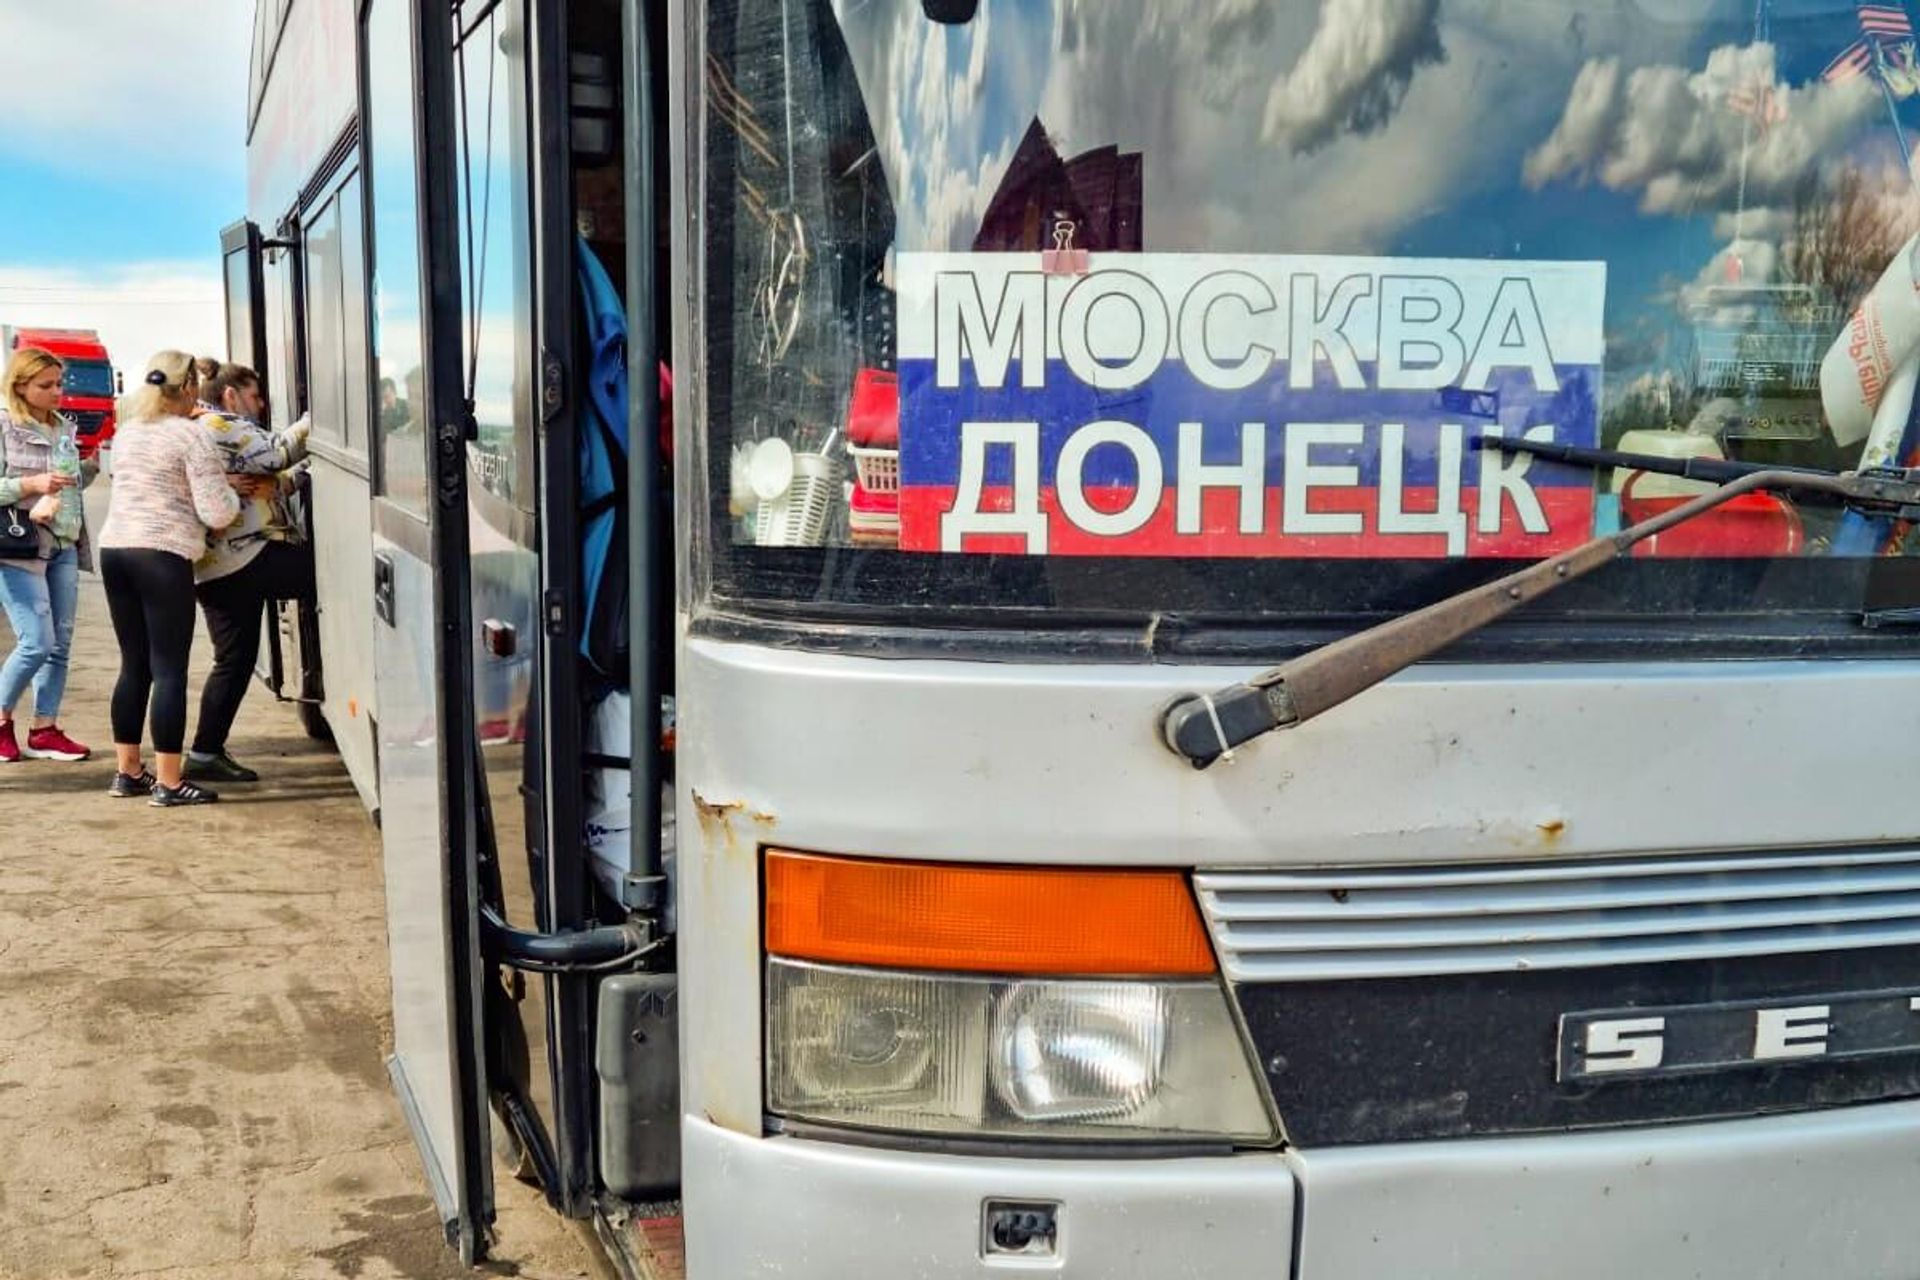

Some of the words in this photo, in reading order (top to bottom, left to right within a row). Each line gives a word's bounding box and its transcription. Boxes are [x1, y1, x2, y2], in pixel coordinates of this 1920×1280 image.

[936, 270, 1560, 392] МОСКВА
[940, 419, 1555, 556] ДОНЕЦК
[1585, 996, 1920, 1073] SE
